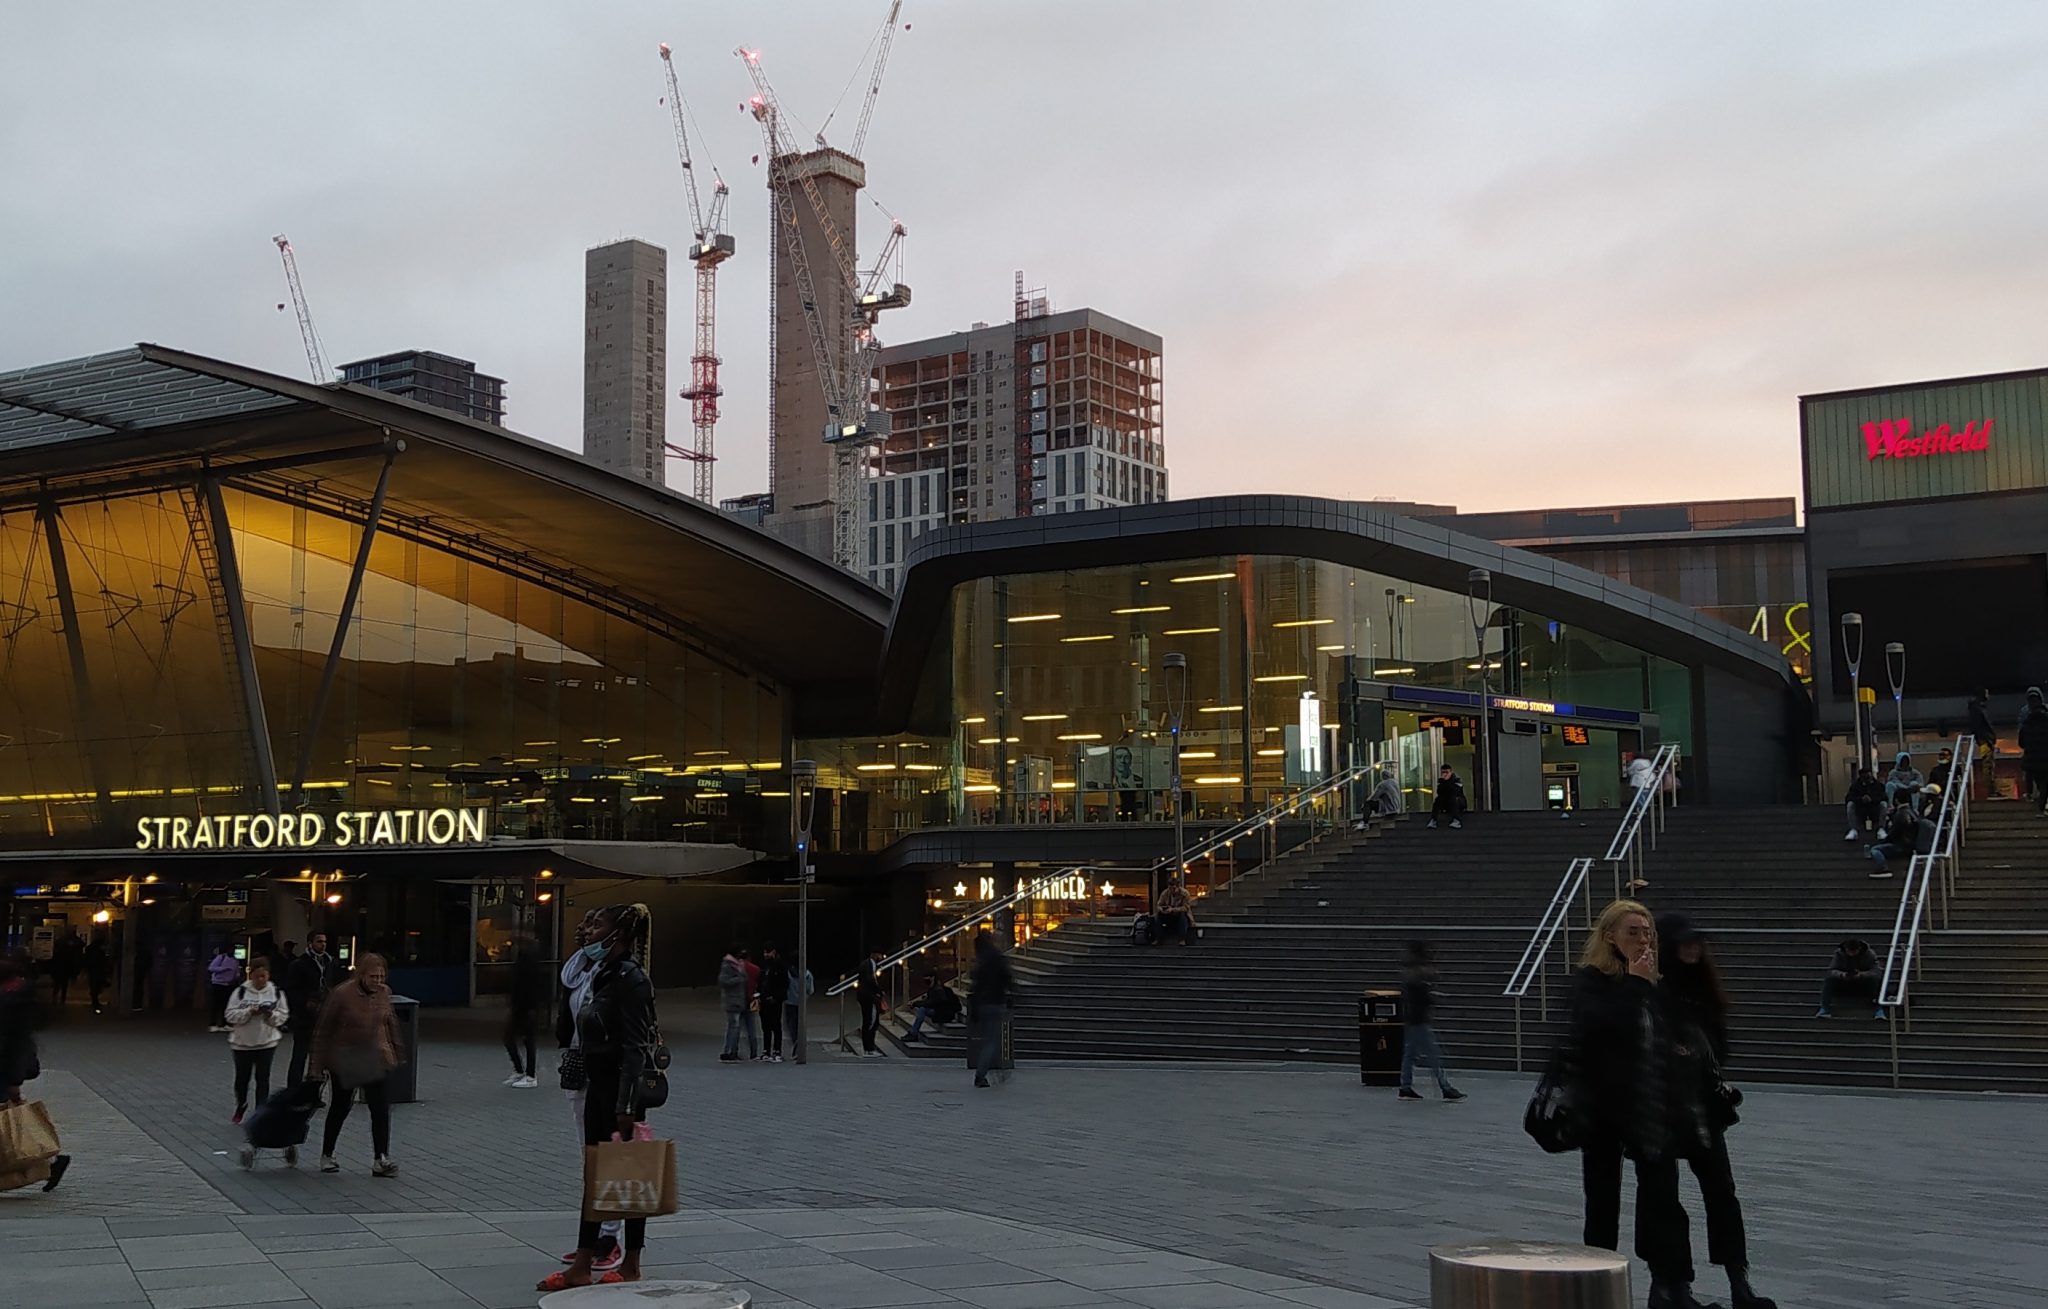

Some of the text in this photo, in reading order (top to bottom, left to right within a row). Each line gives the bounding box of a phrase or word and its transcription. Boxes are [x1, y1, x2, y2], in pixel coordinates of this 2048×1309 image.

[1860, 418, 1994, 461] Westfield
[1493, 698, 1555, 713] STRATFORD STATION
[136, 807, 488, 850] STRATFORD STATION
